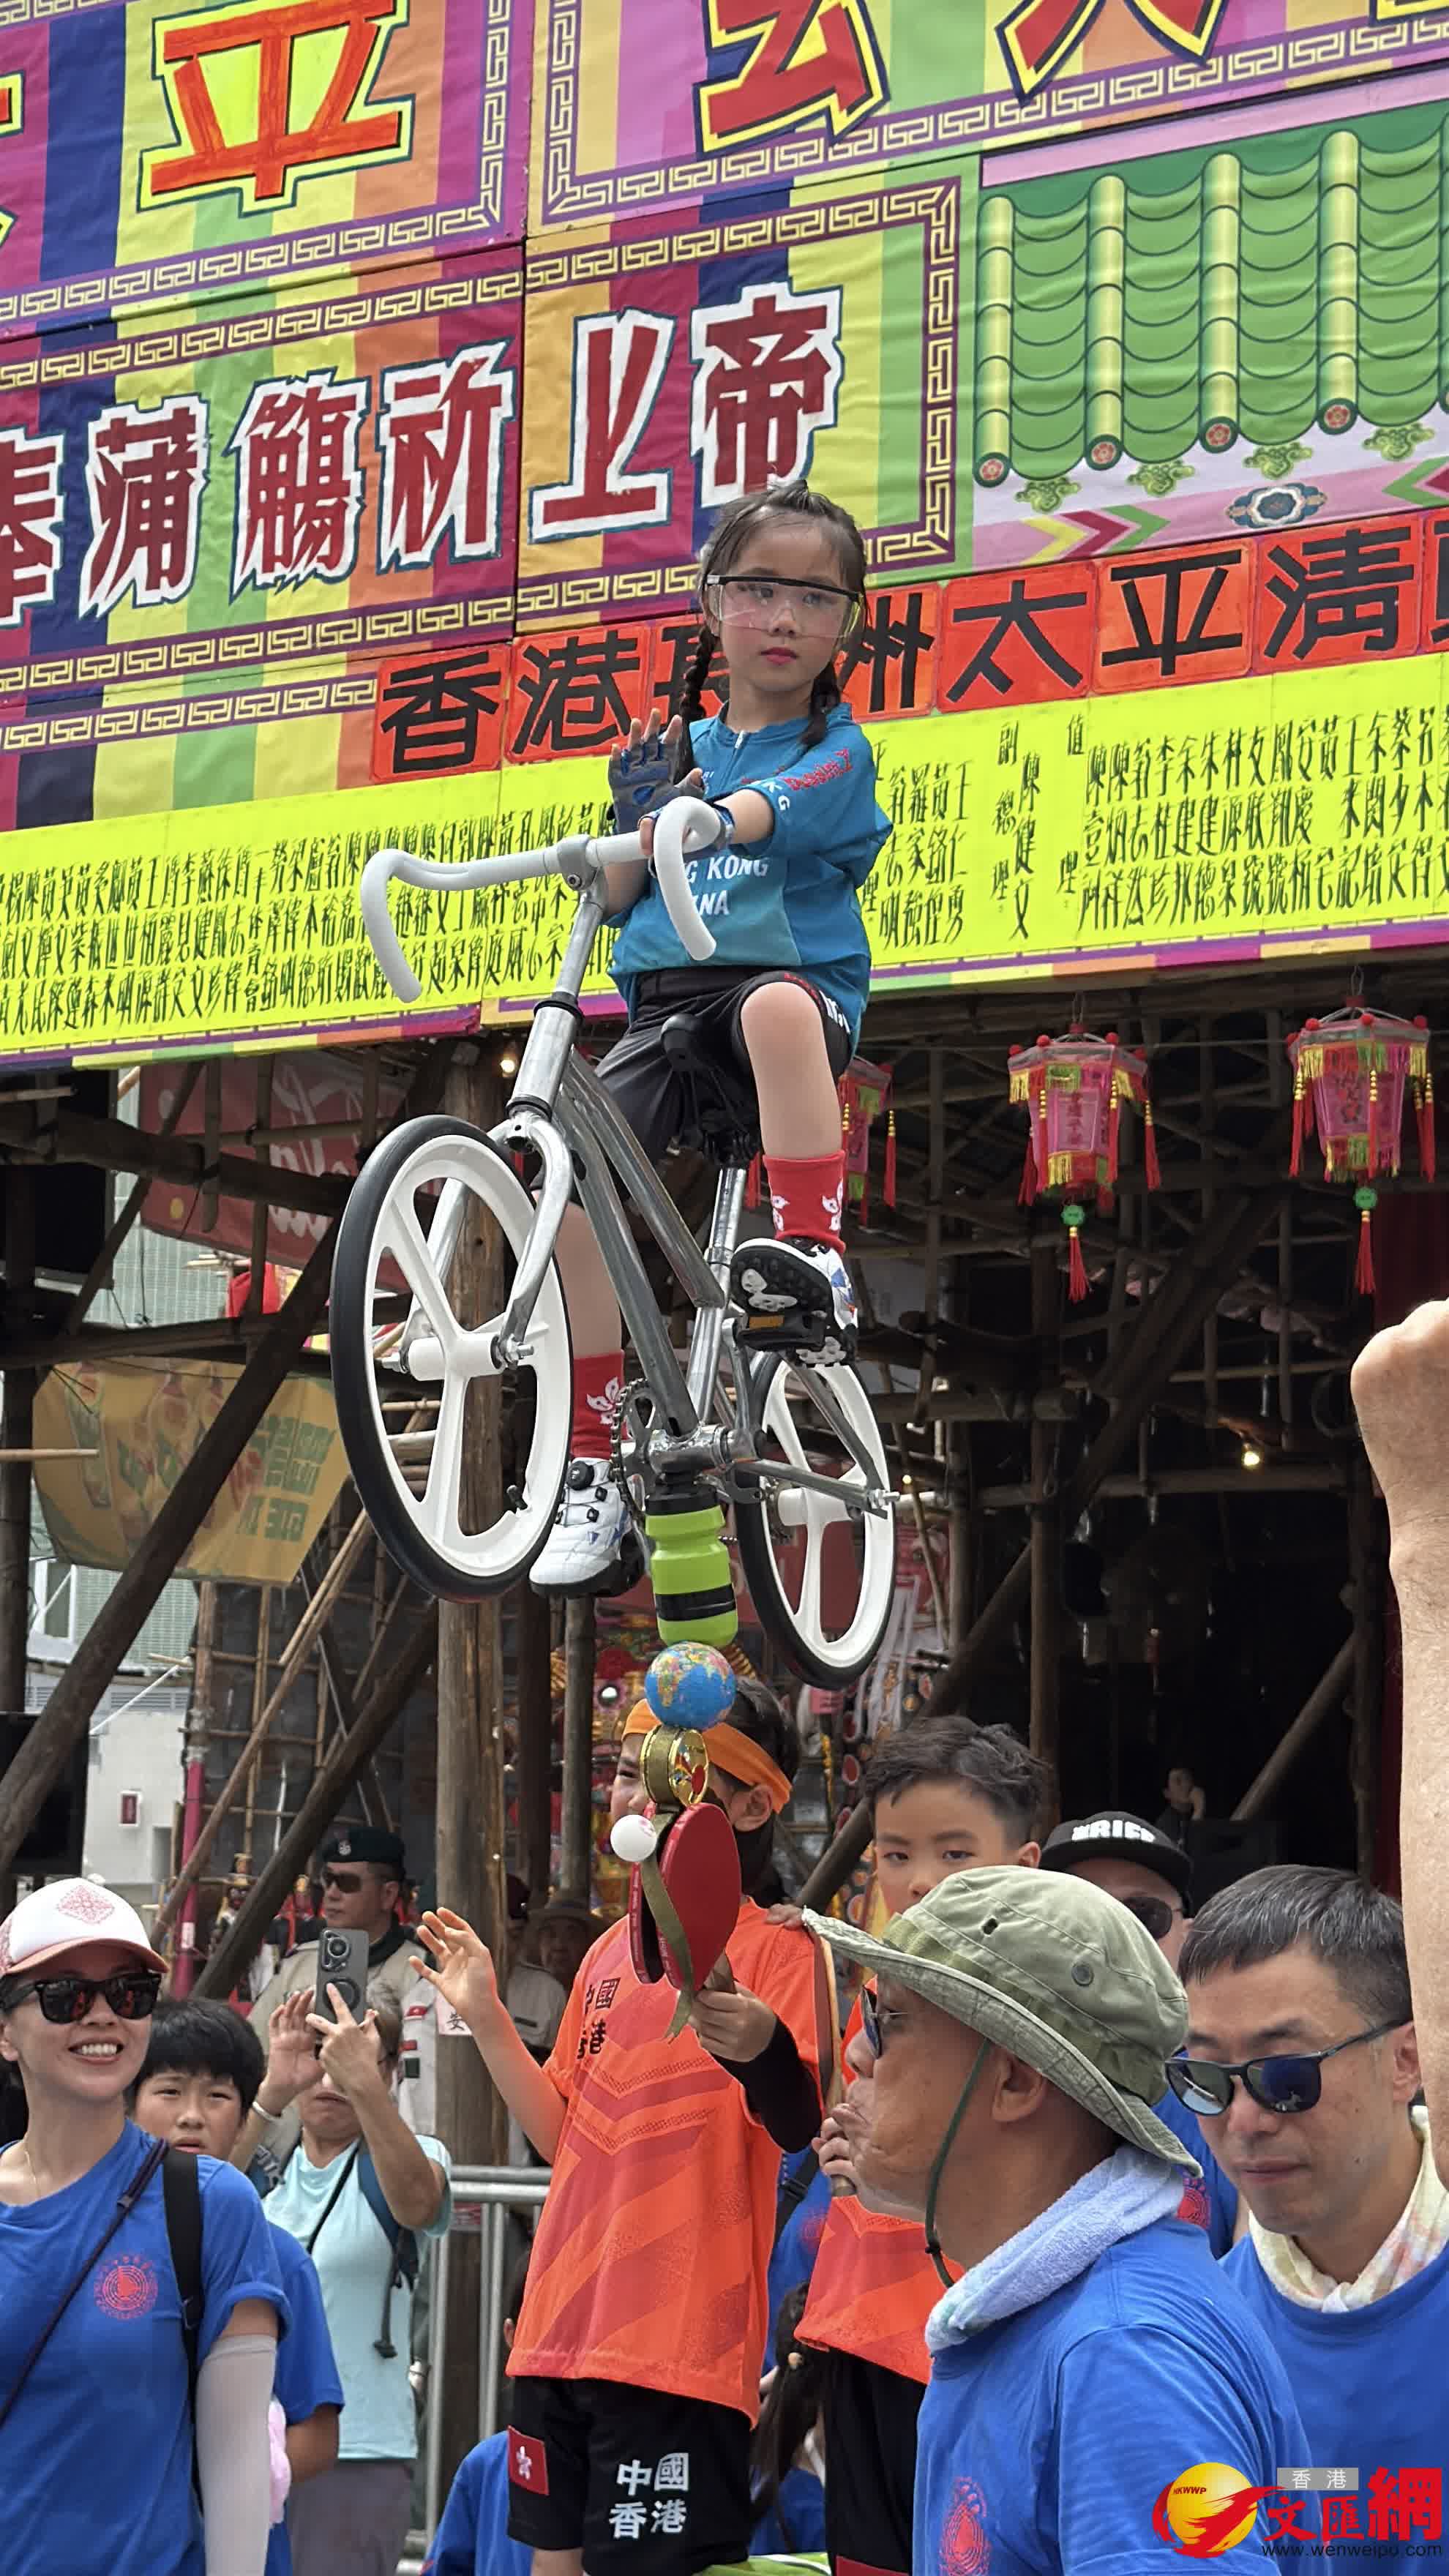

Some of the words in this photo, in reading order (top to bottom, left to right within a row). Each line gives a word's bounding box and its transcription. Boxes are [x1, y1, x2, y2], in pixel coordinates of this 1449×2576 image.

[381, 517, 1449, 774] 香港長洲太平清
[707, 855, 770, 880] KONG
[616, 2452, 689, 2496] 中國
[608, 2498, 688, 2539] 香港
